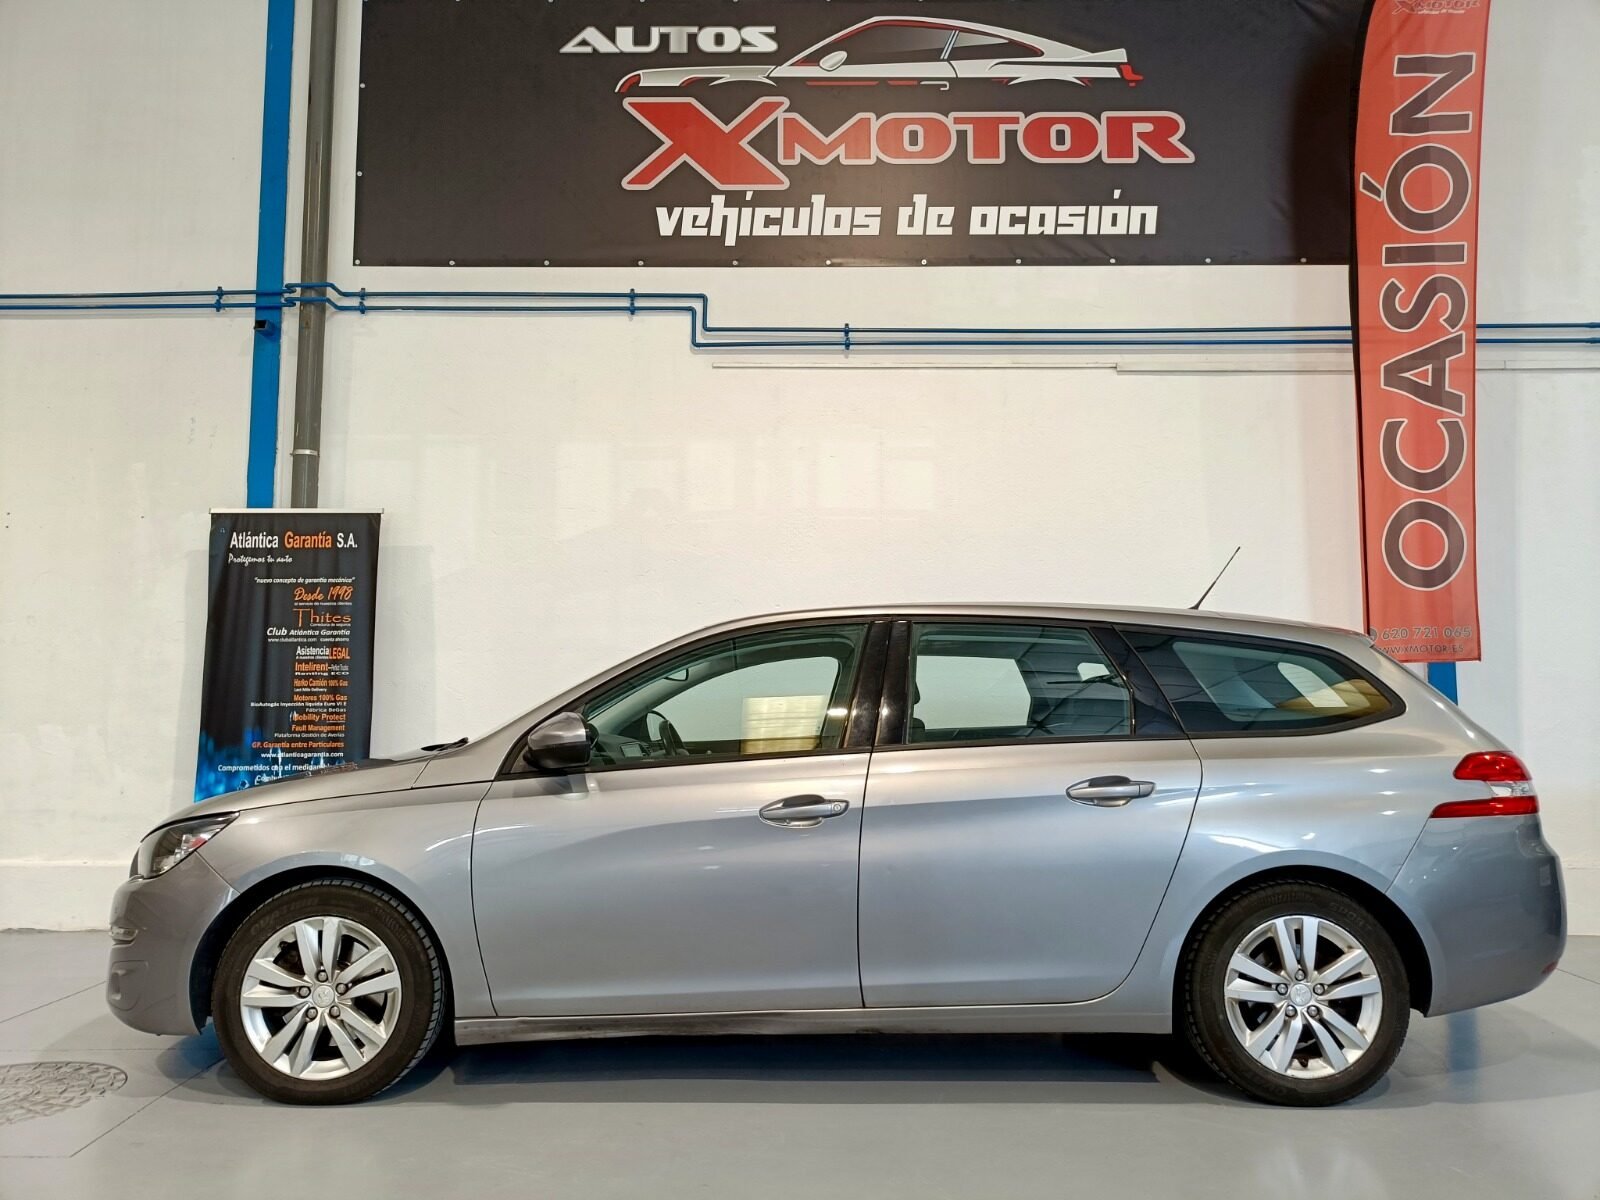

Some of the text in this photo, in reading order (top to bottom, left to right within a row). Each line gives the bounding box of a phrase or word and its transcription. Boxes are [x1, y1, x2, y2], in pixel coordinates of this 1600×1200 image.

[559, 25, 778, 54] AUTOS
[656, 189, 1159, 246] vehículos de ocasión
[1360, 52, 1476, 592] OCASIÓN
[230, 531, 358, 549] Atlántica Garantía S.A.
[267, 554, 275, 563] tu
[276, 554, 293, 563] auto
[294, 586, 353, 601] Desde 1998
[293, 608, 351, 627] Thites
[267, 627, 287, 636] Club
[1382, 626, 1473, 640] 620 721 065
[296, 646, 350, 659] Asistencia LEGAL
[321, 713, 346, 721] Protect
[217, 764, 270, 772] Comprometidos
